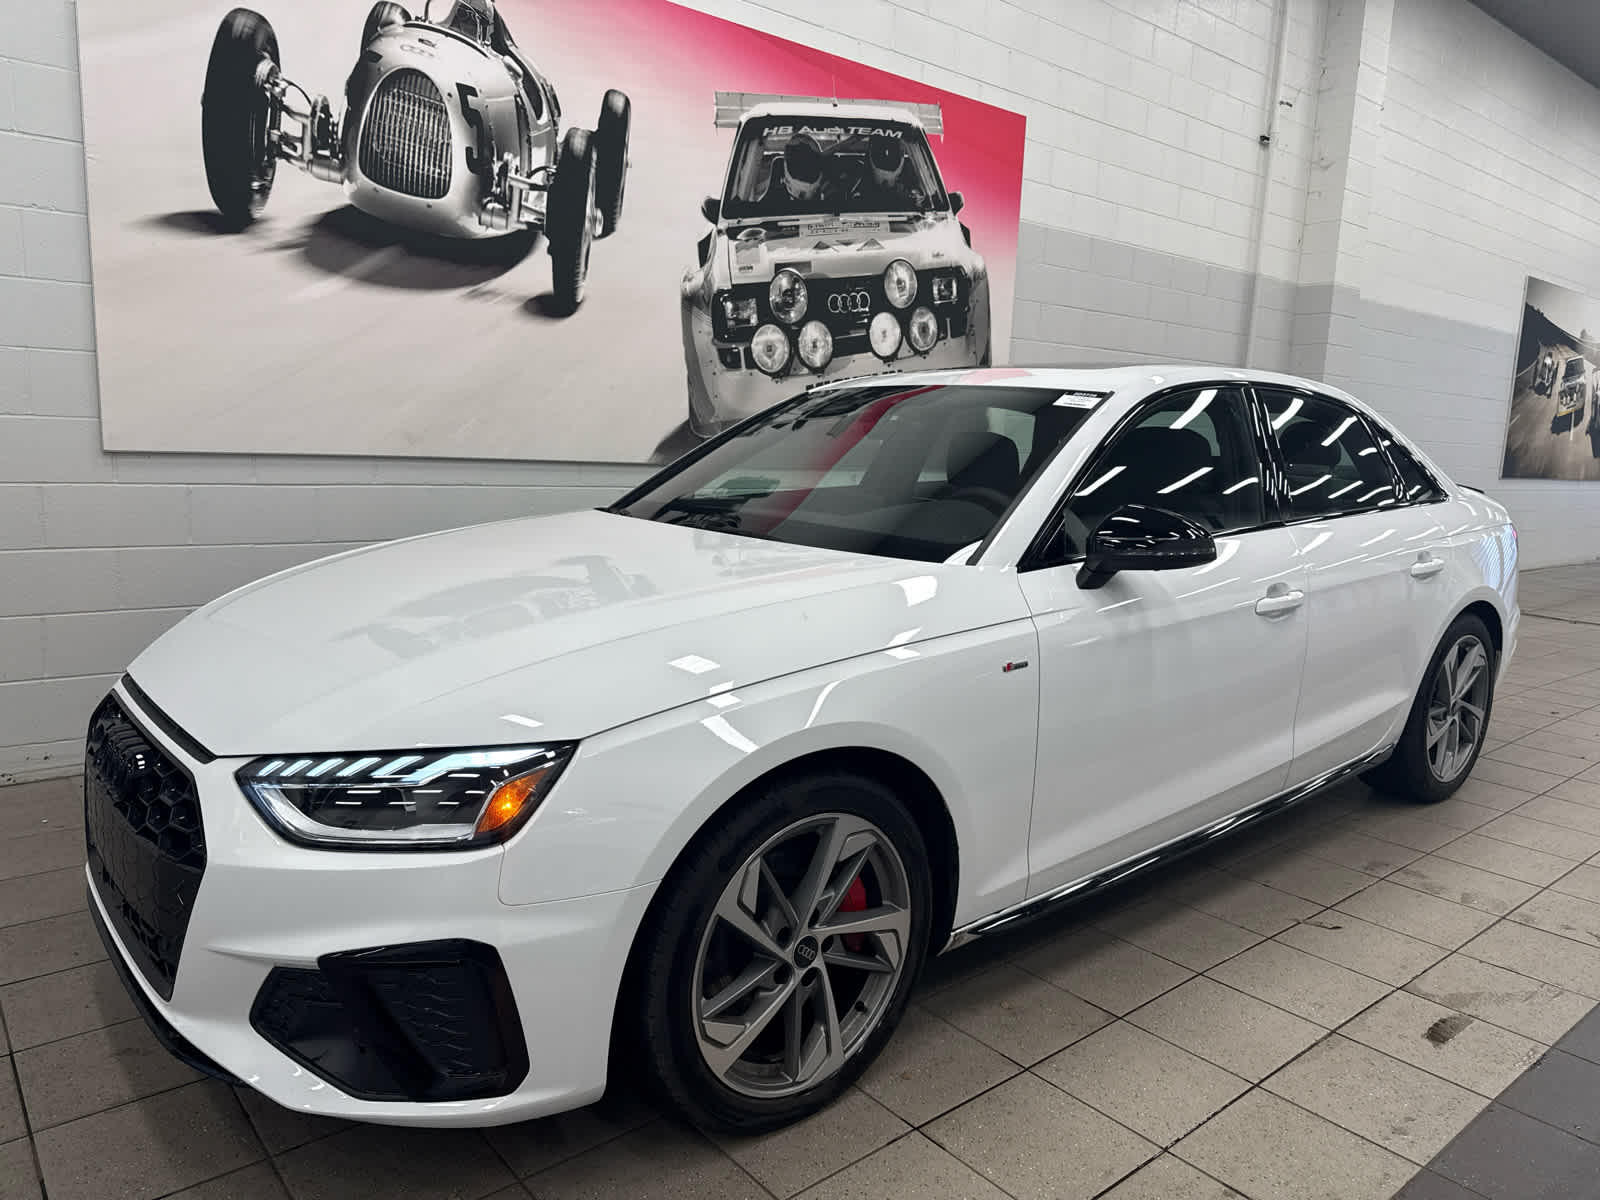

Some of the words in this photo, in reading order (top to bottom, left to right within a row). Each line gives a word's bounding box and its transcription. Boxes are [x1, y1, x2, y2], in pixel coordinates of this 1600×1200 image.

[455, 82, 486, 175] 5
[762, 126, 793, 137] HB
[847, 126, 903, 139] TEAM
